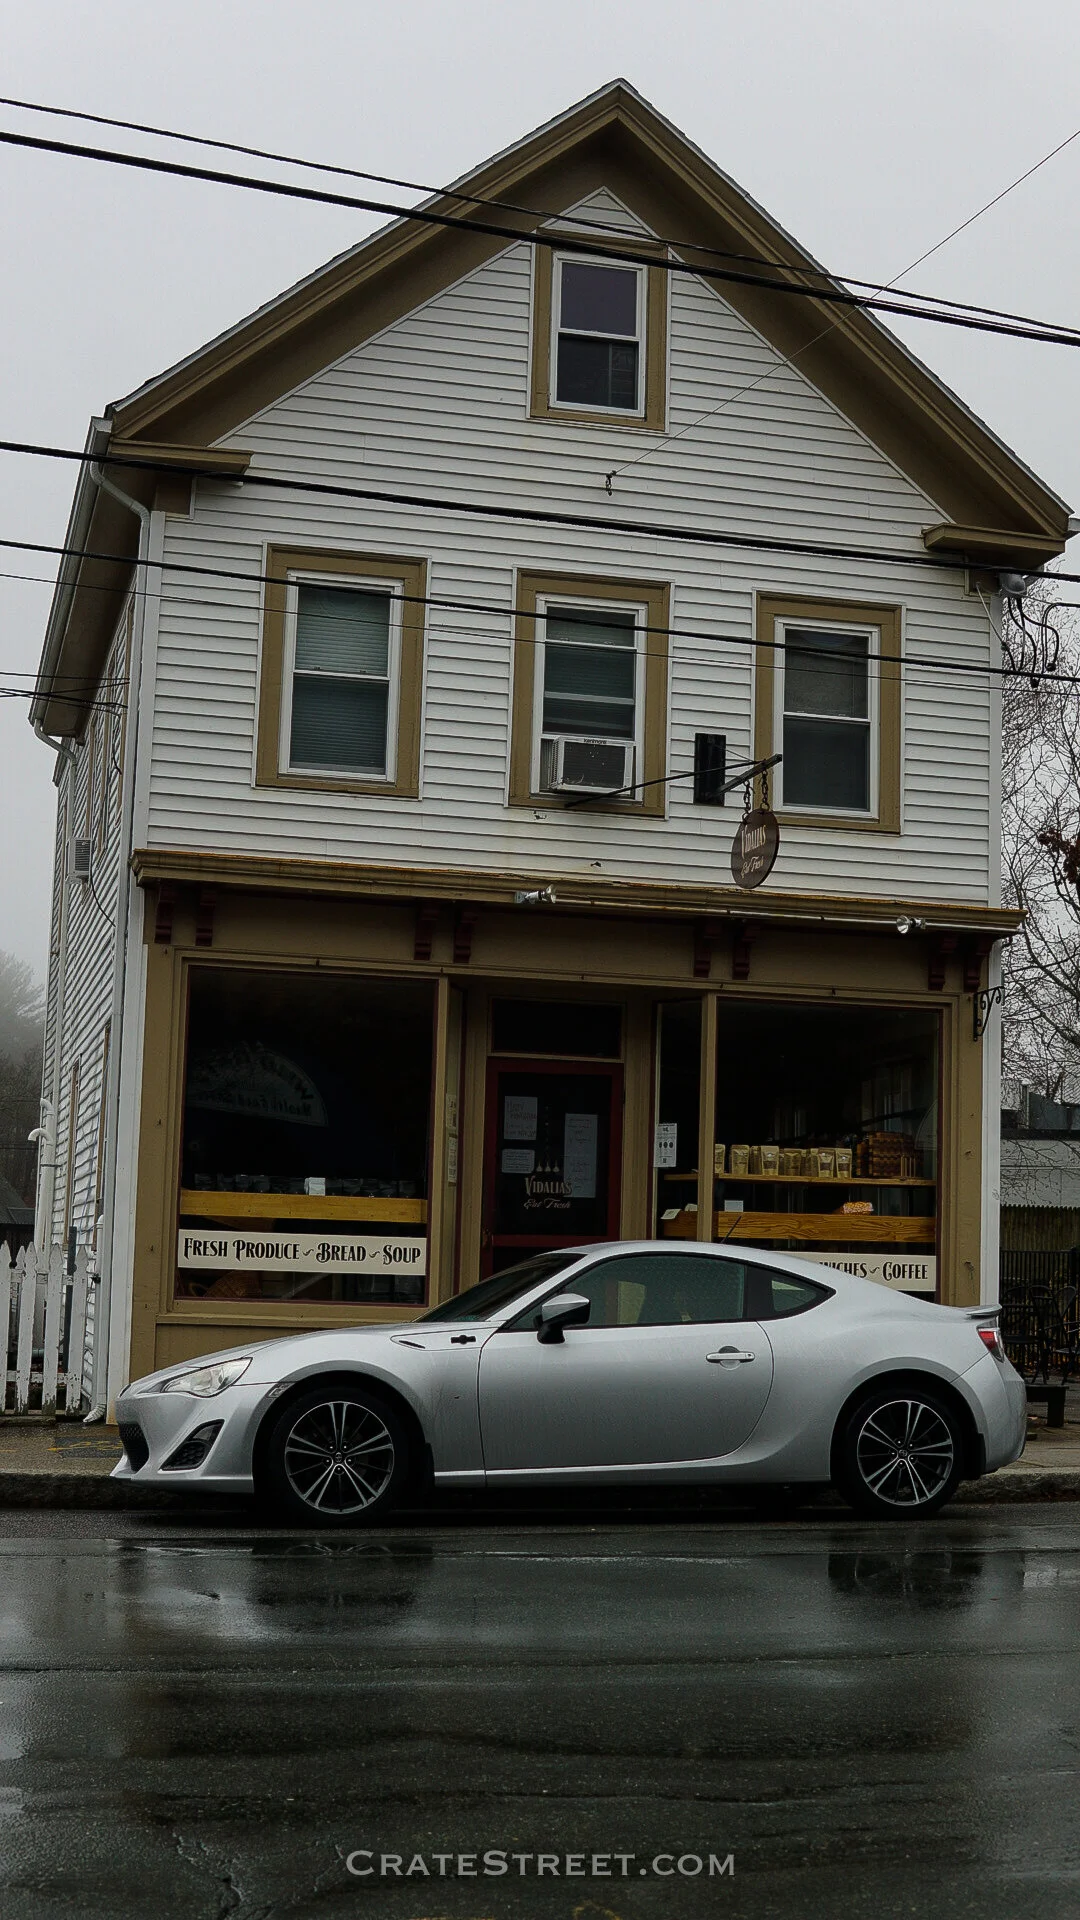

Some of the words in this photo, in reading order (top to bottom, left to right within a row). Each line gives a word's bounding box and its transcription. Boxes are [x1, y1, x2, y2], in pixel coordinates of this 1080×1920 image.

[525, 1175, 571, 1195] VIDALIAS
[184, 1237, 228, 1259] FRESH
[232, 1239, 300, 1261] PRODUCE
[315, 1242, 367, 1263] BREAD
[382, 1245, 421, 1265] SOUP
[882, 1262, 928, 1281] COFFEE
